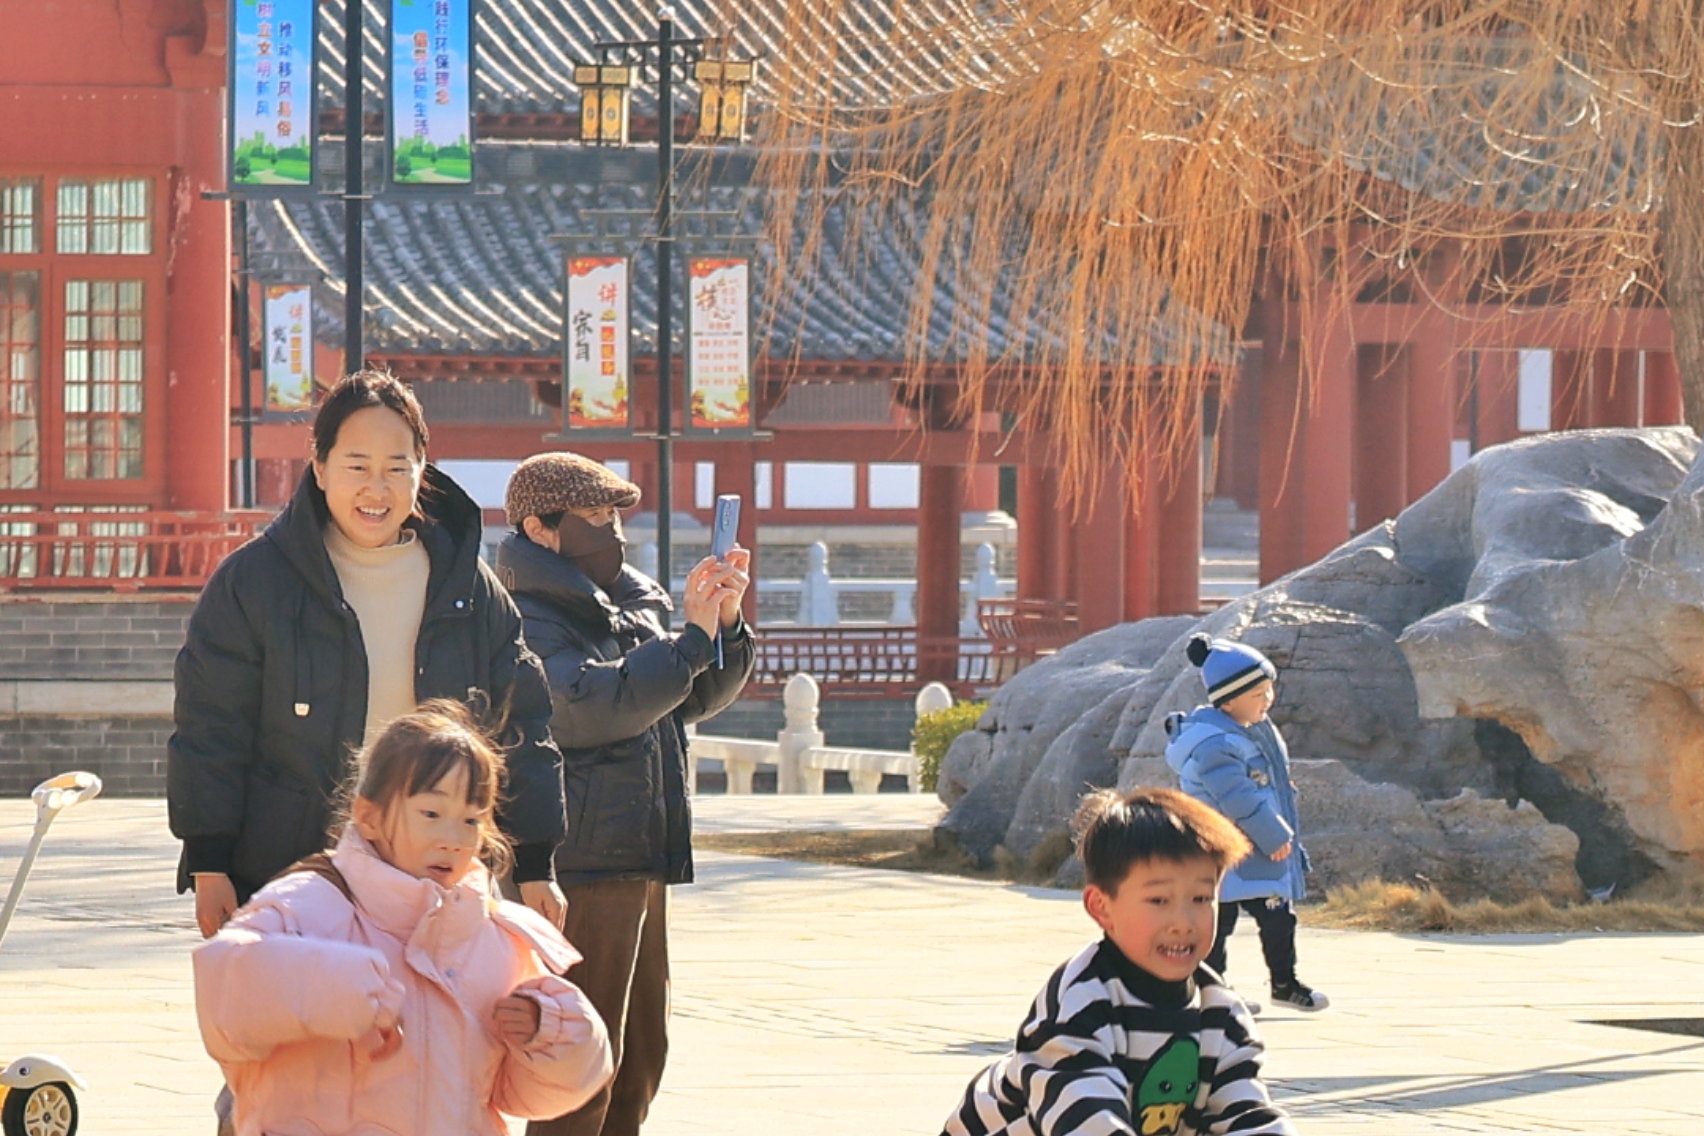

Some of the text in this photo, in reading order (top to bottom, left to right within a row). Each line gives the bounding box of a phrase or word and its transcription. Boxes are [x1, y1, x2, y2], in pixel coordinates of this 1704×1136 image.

[256, 3, 273, 117] 树立文明新风
[277, 22, 293, 137] 推动移风易俗
[413, 31, 428, 135] 倡导低碳生活
[435, 0, 450, 105] 践行环保理念
